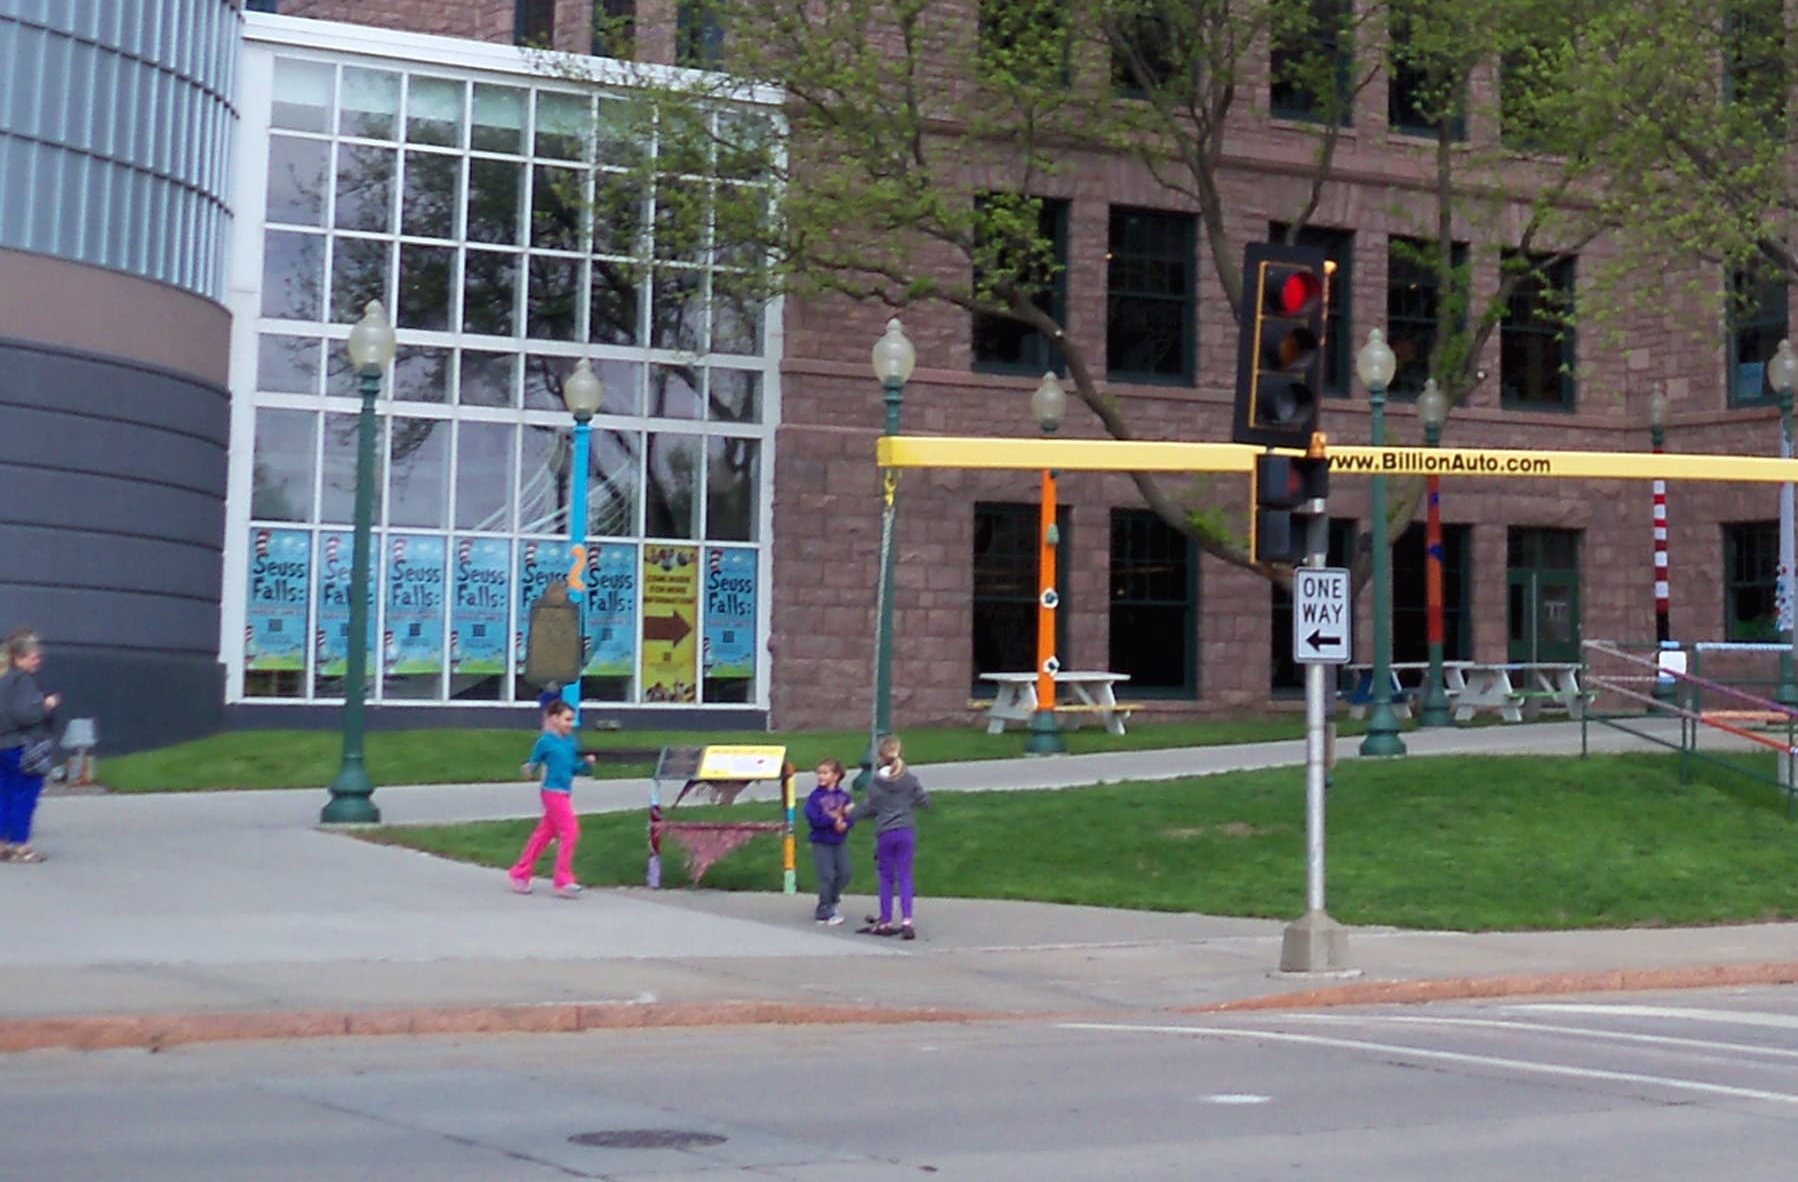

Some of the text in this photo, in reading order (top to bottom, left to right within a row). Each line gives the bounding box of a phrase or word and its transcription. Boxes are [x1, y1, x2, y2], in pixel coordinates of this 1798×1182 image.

[254, 553, 305, 578] Seuss
[391, 560, 440, 583] Seuss
[457, 561, 505, 585] Seuss
[253, 577, 305, 602] Falls:
[587, 568, 633, 589] Seuss
[708, 570, 752, 593] Seuss
[1303, 578, 1342, 598] ONE
[324, 582, 374, 607] Fal:
[392, 583, 440, 607] Falls:
[457, 584, 505, 608] Falls:
[588, 591, 633, 611] Falls:
[709, 593, 752, 616] Falls:
[1303, 603, 1343, 624] WAY
